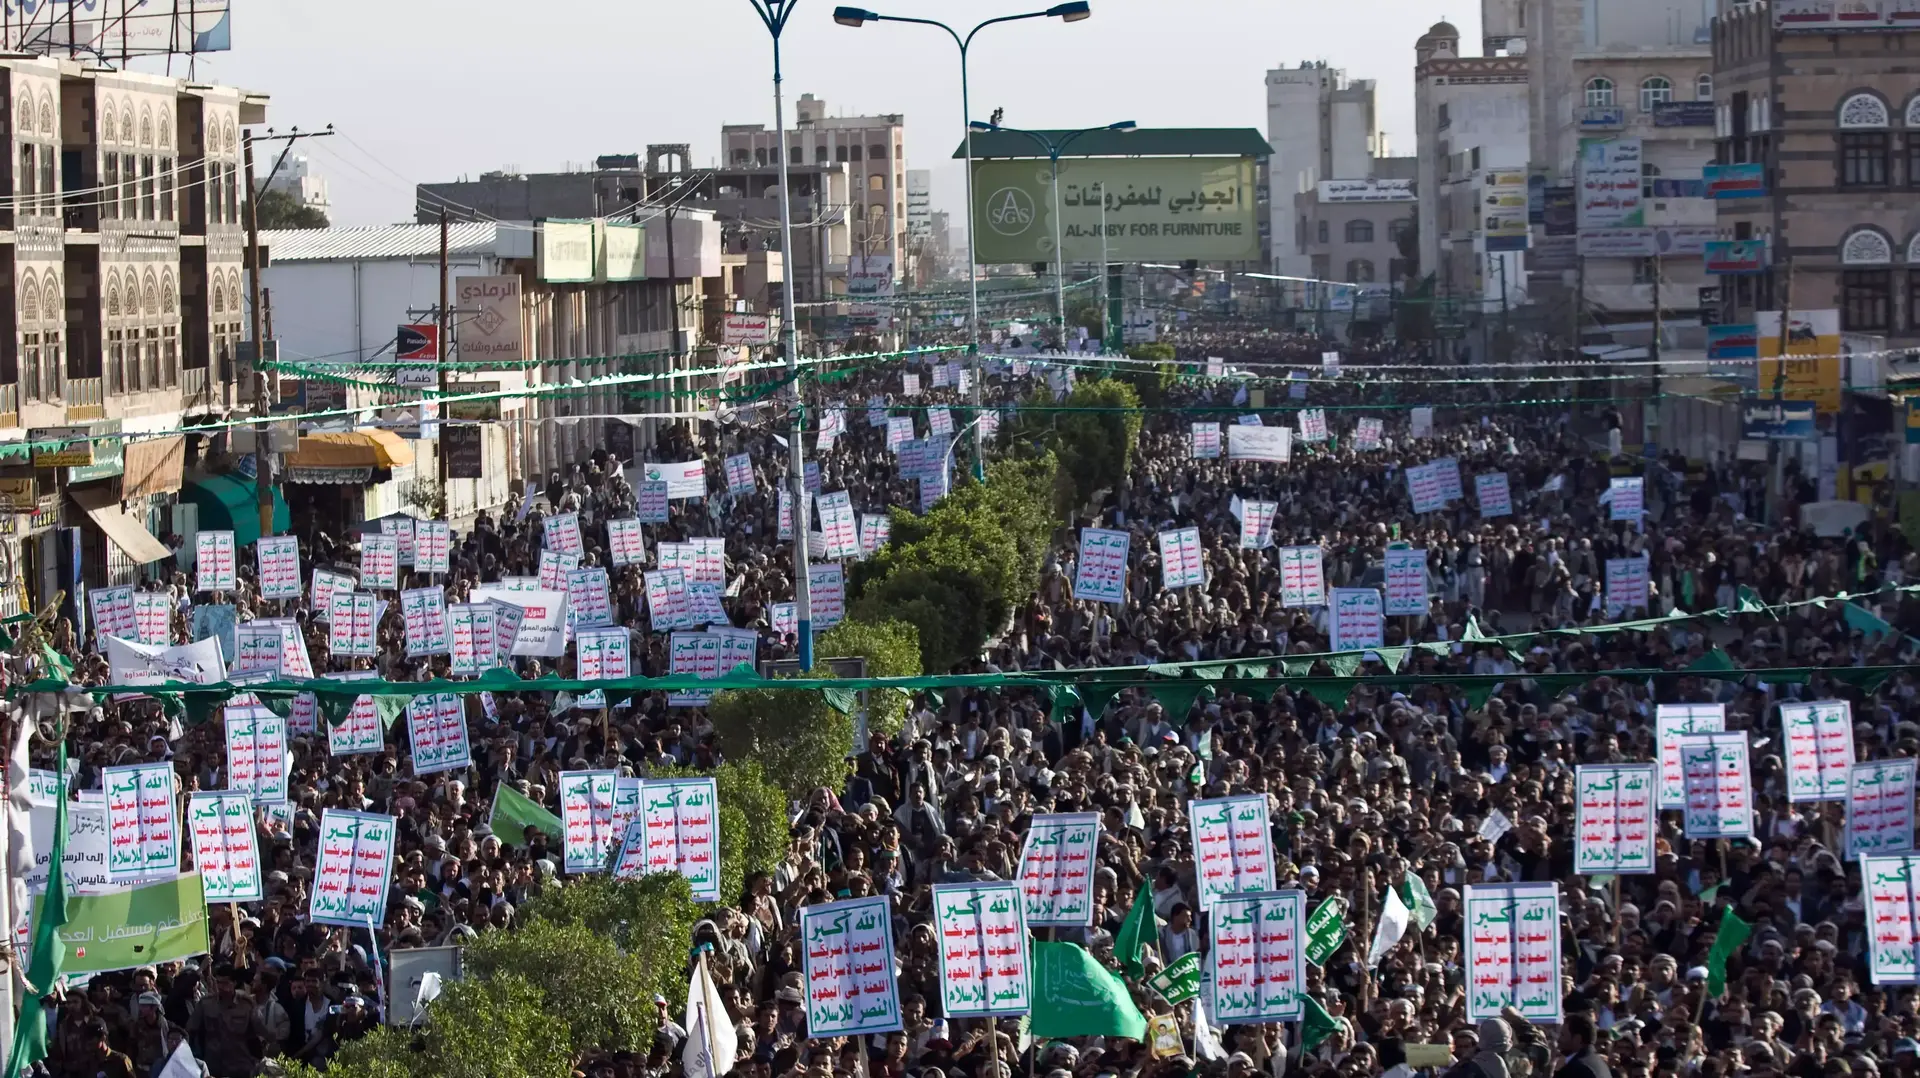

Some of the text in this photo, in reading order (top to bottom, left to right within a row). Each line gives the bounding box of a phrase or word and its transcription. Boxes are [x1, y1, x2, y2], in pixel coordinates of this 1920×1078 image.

[1064, 182, 1241, 214] الجوبي للمفروشات
[1066, 223, 1242, 236] AL-JOBY FOR FURNITURE
[461, 282, 516, 304] الرمادي
[727, 318, 766, 331] صيدلية
[462, 340, 518, 355] للمفروشات
[402, 374, 431, 383] ظفار
[230, 720, 279, 740] الله أكبر
[109, 772, 166, 796] الله أكبر
[143, 794, 168, 808] الموت
[646, 786, 709, 812] الله أكبر
[144, 811, 169, 825] الموت
[682, 813, 710, 827] الموت
[111, 828, 170, 846] اللعنة على اليهود
[325, 820, 388, 841] الله أكبر
[683, 832, 710, 846] الموت
[1029, 827, 1091, 848] الله أكبر
[86, 853, 104, 864] إلى
[112, 843, 172, 868] النصر للإسلام
[358, 848, 385, 859] الموت
[648, 850, 711, 865] اللعنة على اليهود
[1062, 848, 1090, 860] الموت
[356, 866, 383, 877] الموت
[1060, 864, 1088, 877] الموت
[205, 876, 228, 894] للإسلا
[319, 881, 380, 894] اللعنة على اليهود
[1048, 883, 1061, 895] على
[1065, 881, 1087, 892] اللعنة
[315, 895, 378, 916] النصر للإسلام
[942, 892, 1015, 921] الله أكبر
[1027, 896, 1085, 919] النصر للإسلا
[1474, 900, 1550, 928] الله أكبر
[1218, 901, 1292, 930] الله أكبر
[1309, 911, 1331, 934] لبيك
[99, 923, 153, 943] مستقبل
[810, 909, 881, 940] الله أكبر
[986, 921, 1018, 936] الموت
[851, 934, 884, 952] الموت
[1261, 928, 1293, 944] الموت
[1518, 929, 1551, 944] الموت
[988, 942, 1020, 958] الموت
[1262, 949, 1294, 965] الموت
[1311, 943, 1326, 960] الله
[1518, 950, 1551, 965] الموت
[853, 955, 886, 972] الموت
[947, 962, 1022, 980] اللعنة على اليهود
[1219, 969, 1294, 989] اللعنة على اليهود
[1474, 970, 1552, 986] اللعنة على اليهود
[813, 976, 888, 999] اللعنة على اليهود
[949, 980, 1024, 1007] النصر للإسلام
[1220, 987, 1295, 1015] النصر للإسلام
[1517, 987, 1552, 1011] النصر
[814, 995, 891, 1027] النصر للإسلام
